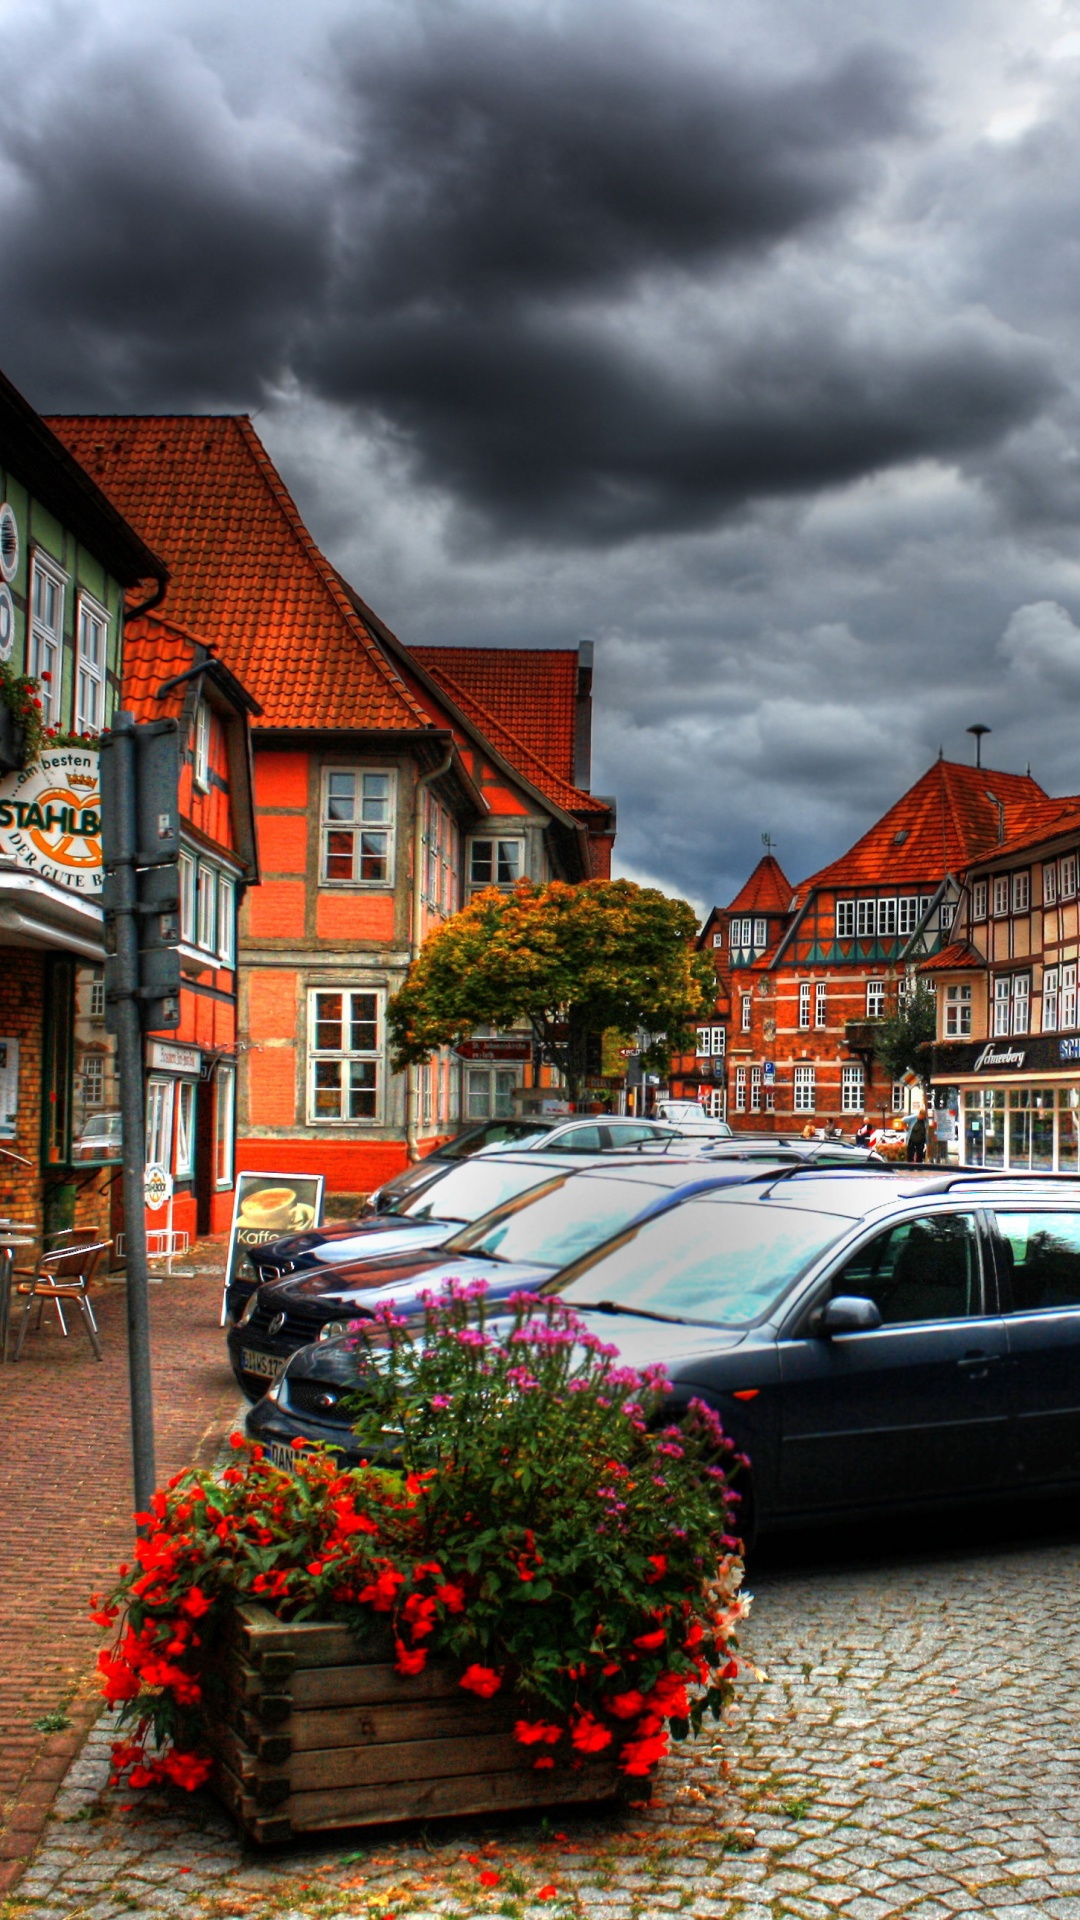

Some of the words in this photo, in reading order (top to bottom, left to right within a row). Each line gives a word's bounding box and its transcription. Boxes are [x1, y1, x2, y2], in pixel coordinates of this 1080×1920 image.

[41, 754, 91, 770] besten
[0, 800, 101, 836] STAHLB
[8, 832, 37, 866] DER
[40, 864, 85, 888] GUTE
[765, 1063, 772, 1072] P
[974, 1043, 1025, 1072] Schneeberg
